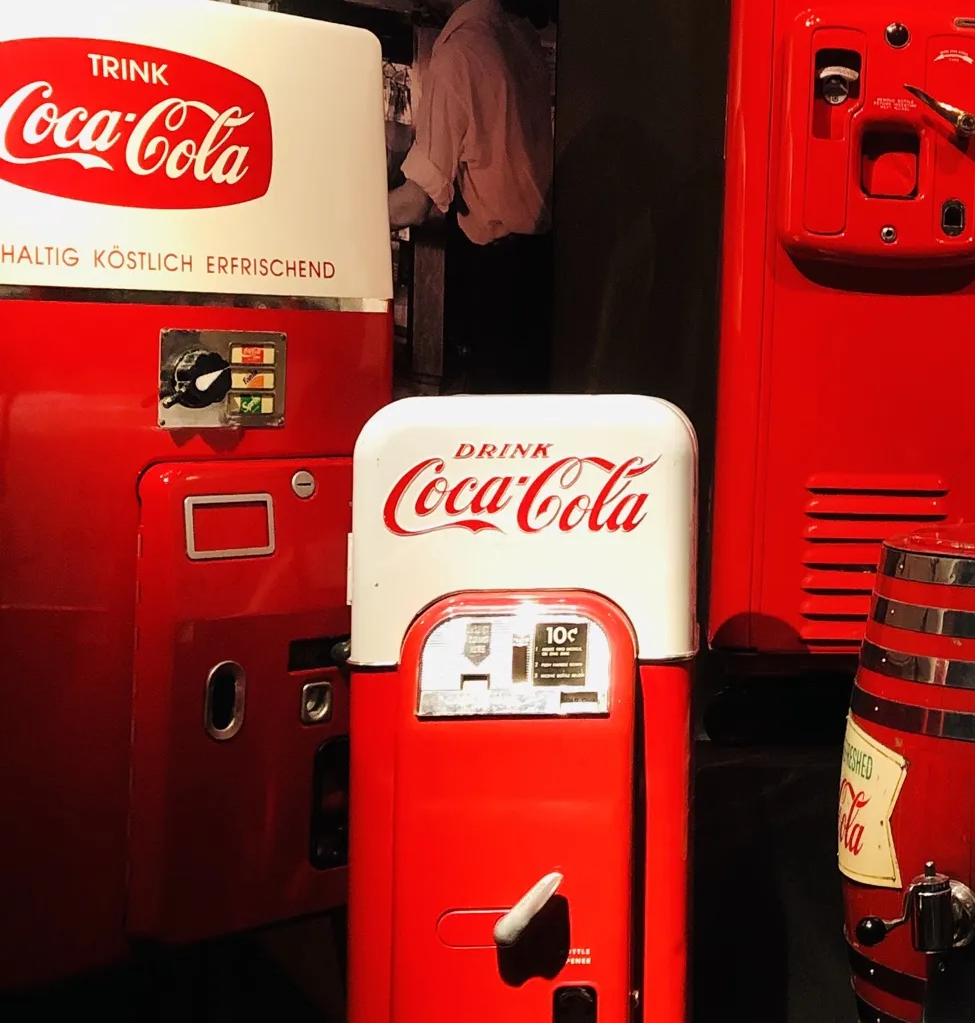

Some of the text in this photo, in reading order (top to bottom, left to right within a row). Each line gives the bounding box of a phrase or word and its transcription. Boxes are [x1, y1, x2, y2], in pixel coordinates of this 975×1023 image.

[87, 53, 169, 86] TRINK
[0, 80, 255, 185] Coca-Cola
[1, 244, 336, 279] HALTIG KÖSTLICH ERFRISCHEND
[453, 442, 554, 459] DRINK
[383, 453, 663, 537] Coca-Cola
[546, 626, 579, 645] 10¢
